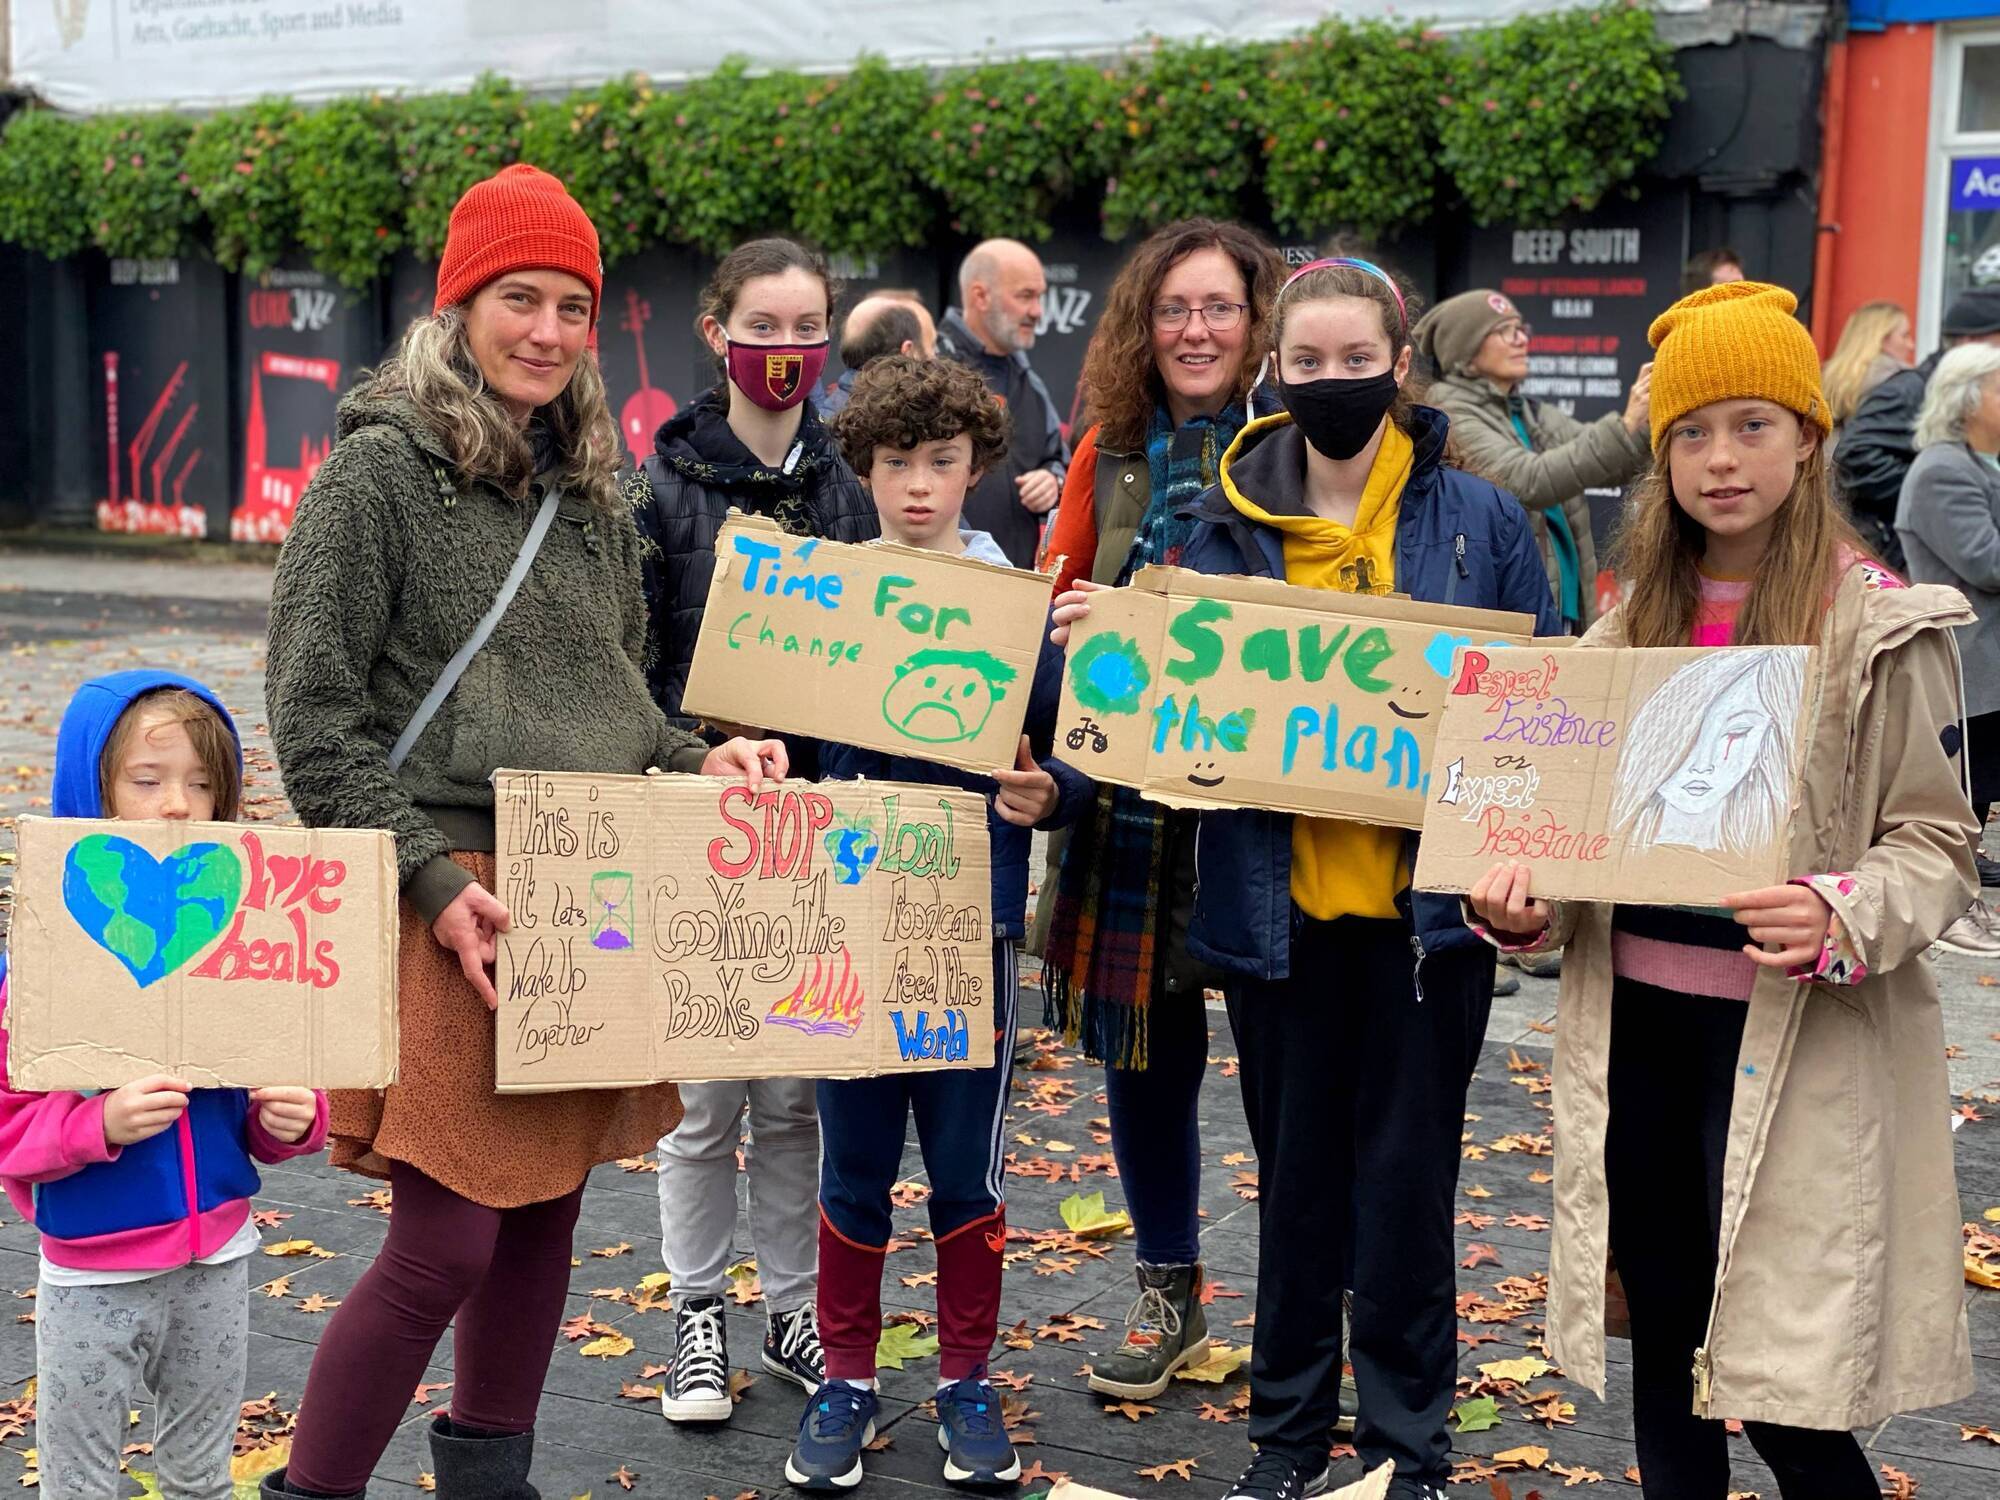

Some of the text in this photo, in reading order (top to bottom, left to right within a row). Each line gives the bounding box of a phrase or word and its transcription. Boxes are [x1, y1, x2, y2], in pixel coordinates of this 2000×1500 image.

[311, 5, 344, 30] and
[1512, 228, 1640, 263] DEEP SOUTH
[733, 535, 972, 641] Time For
[728, 612, 864, 667] Change
[1165, 598, 1397, 695] Save
[1452, 651, 1558, 712] Respect
[1151, 693, 1257, 755] the
[1483, 698, 1616, 747] Existence
[1437, 756, 1540, 822] Expect
[1494, 755, 1531, 769] or
[505, 773, 620, 859] This is
[707, 786, 834, 881] STOP
[876, 794, 961, 880] Local
[1474, 806, 1609, 861] Resistance
[506, 858, 538, 929] it
[792, 868, 846, 955] The
[515, 997, 605, 1067] Together
[888, 1009, 970, 1062] World
